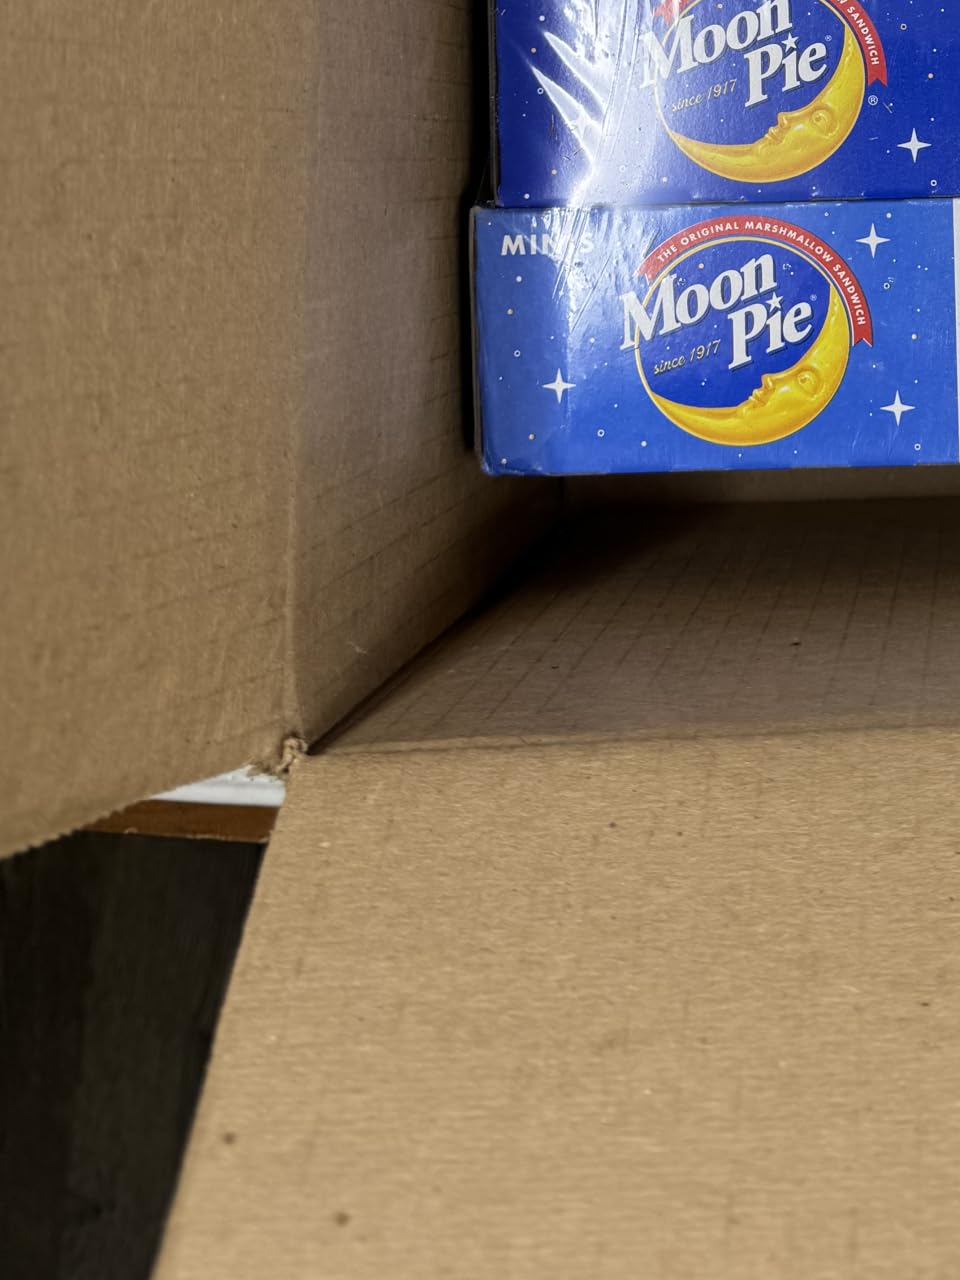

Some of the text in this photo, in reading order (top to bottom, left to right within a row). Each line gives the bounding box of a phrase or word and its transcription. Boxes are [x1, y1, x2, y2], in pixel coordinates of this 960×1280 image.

[846, 6, 880, 66] SANDWICH
[671, 79, 737, 111] since 1917
[744, 33, 827, 109] Pie
[501, 230, 594, 256] MINS
[658, 221, 866, 326] THE ORIGINAL MARSHMALLOW SANDWICH
[619, 253, 812, 371] Moon Pie
[653, 340, 720, 376] since 1917
